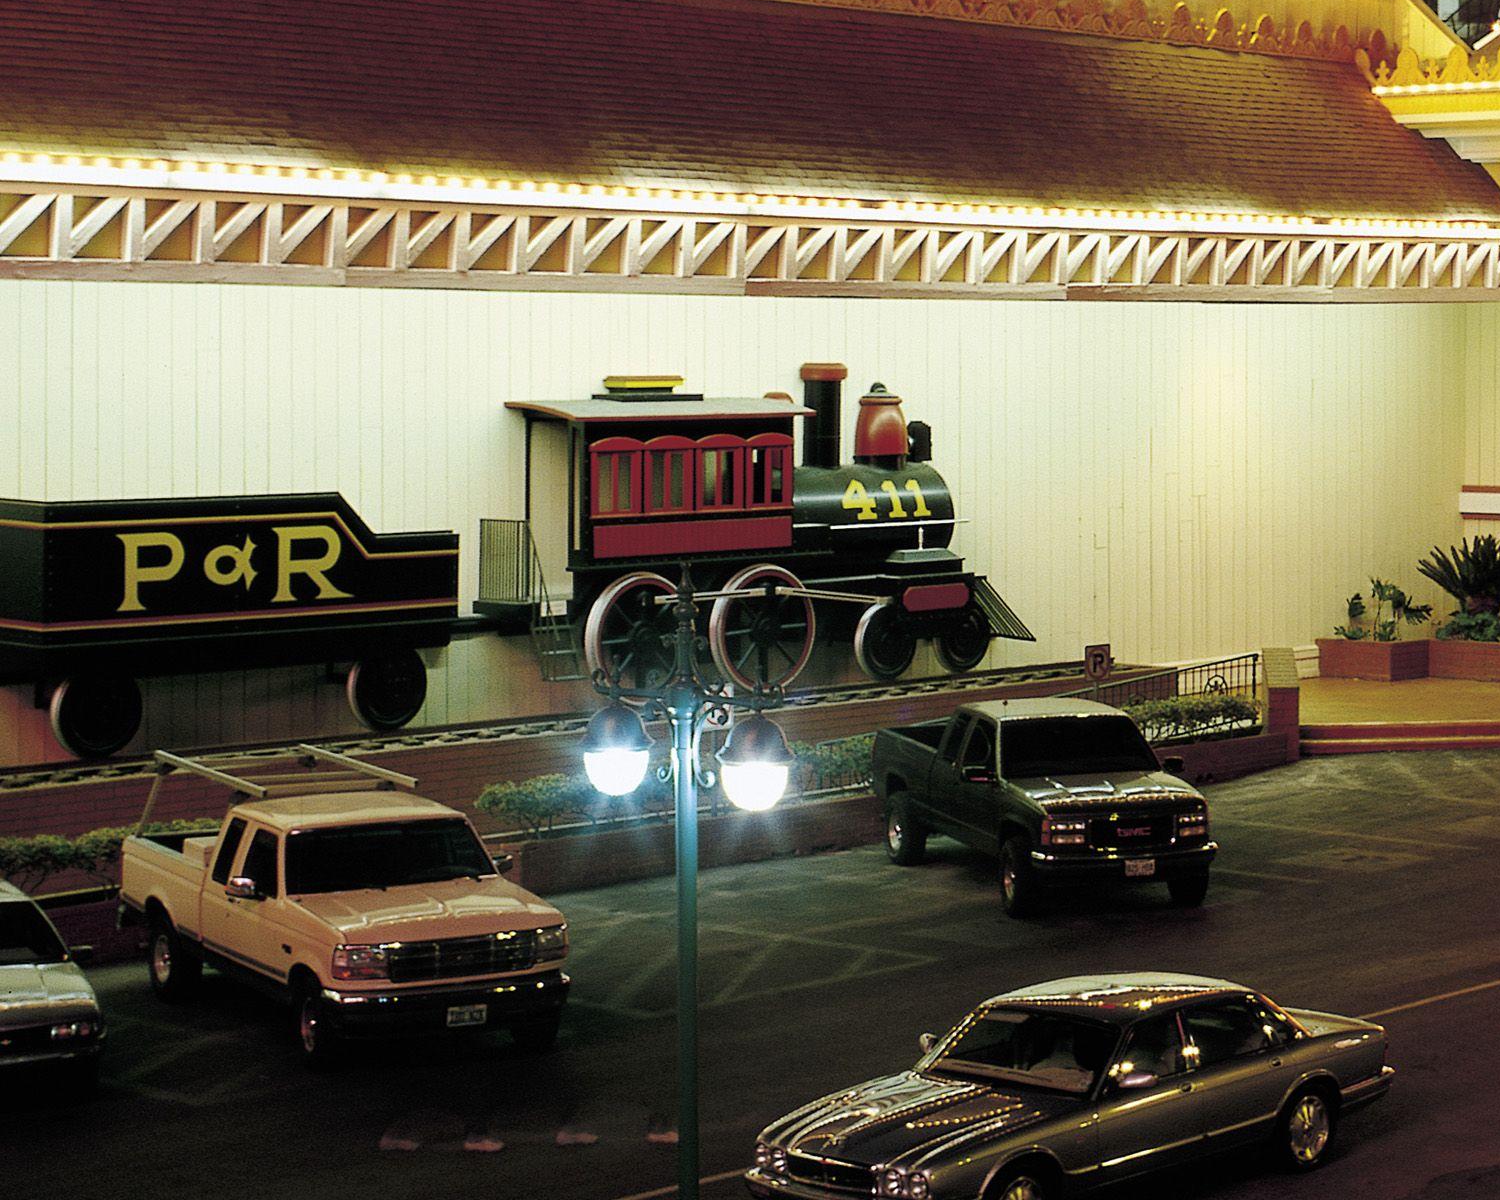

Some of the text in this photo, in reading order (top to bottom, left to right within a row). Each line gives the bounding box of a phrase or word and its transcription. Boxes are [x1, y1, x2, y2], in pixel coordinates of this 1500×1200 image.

[842, 479, 931, 520] 411
[115, 531, 185, 611] P
[270, 525, 355, 602] R
[1116, 825, 1151, 837] GMC
